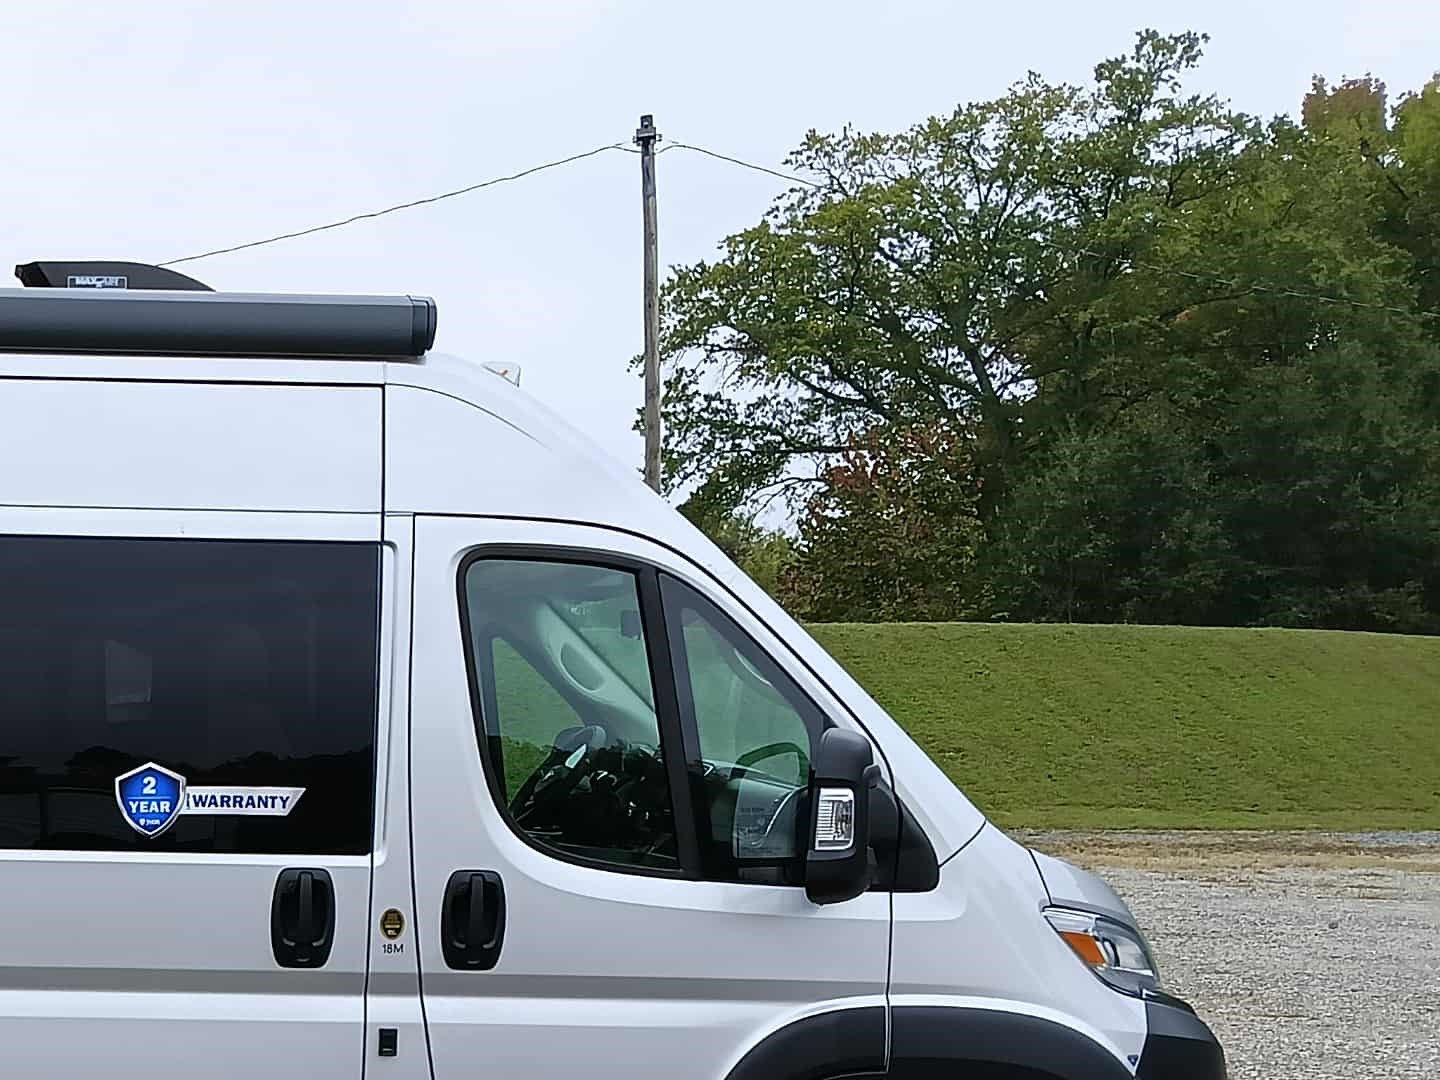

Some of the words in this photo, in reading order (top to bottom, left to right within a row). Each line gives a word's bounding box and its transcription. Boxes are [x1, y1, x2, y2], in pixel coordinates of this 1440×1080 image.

[143, 777, 156, 794] 2
[129, 800, 170, 813] YEAR
[192, 795, 290, 809] WARRANTY
[382, 943, 404, 954] 18M
